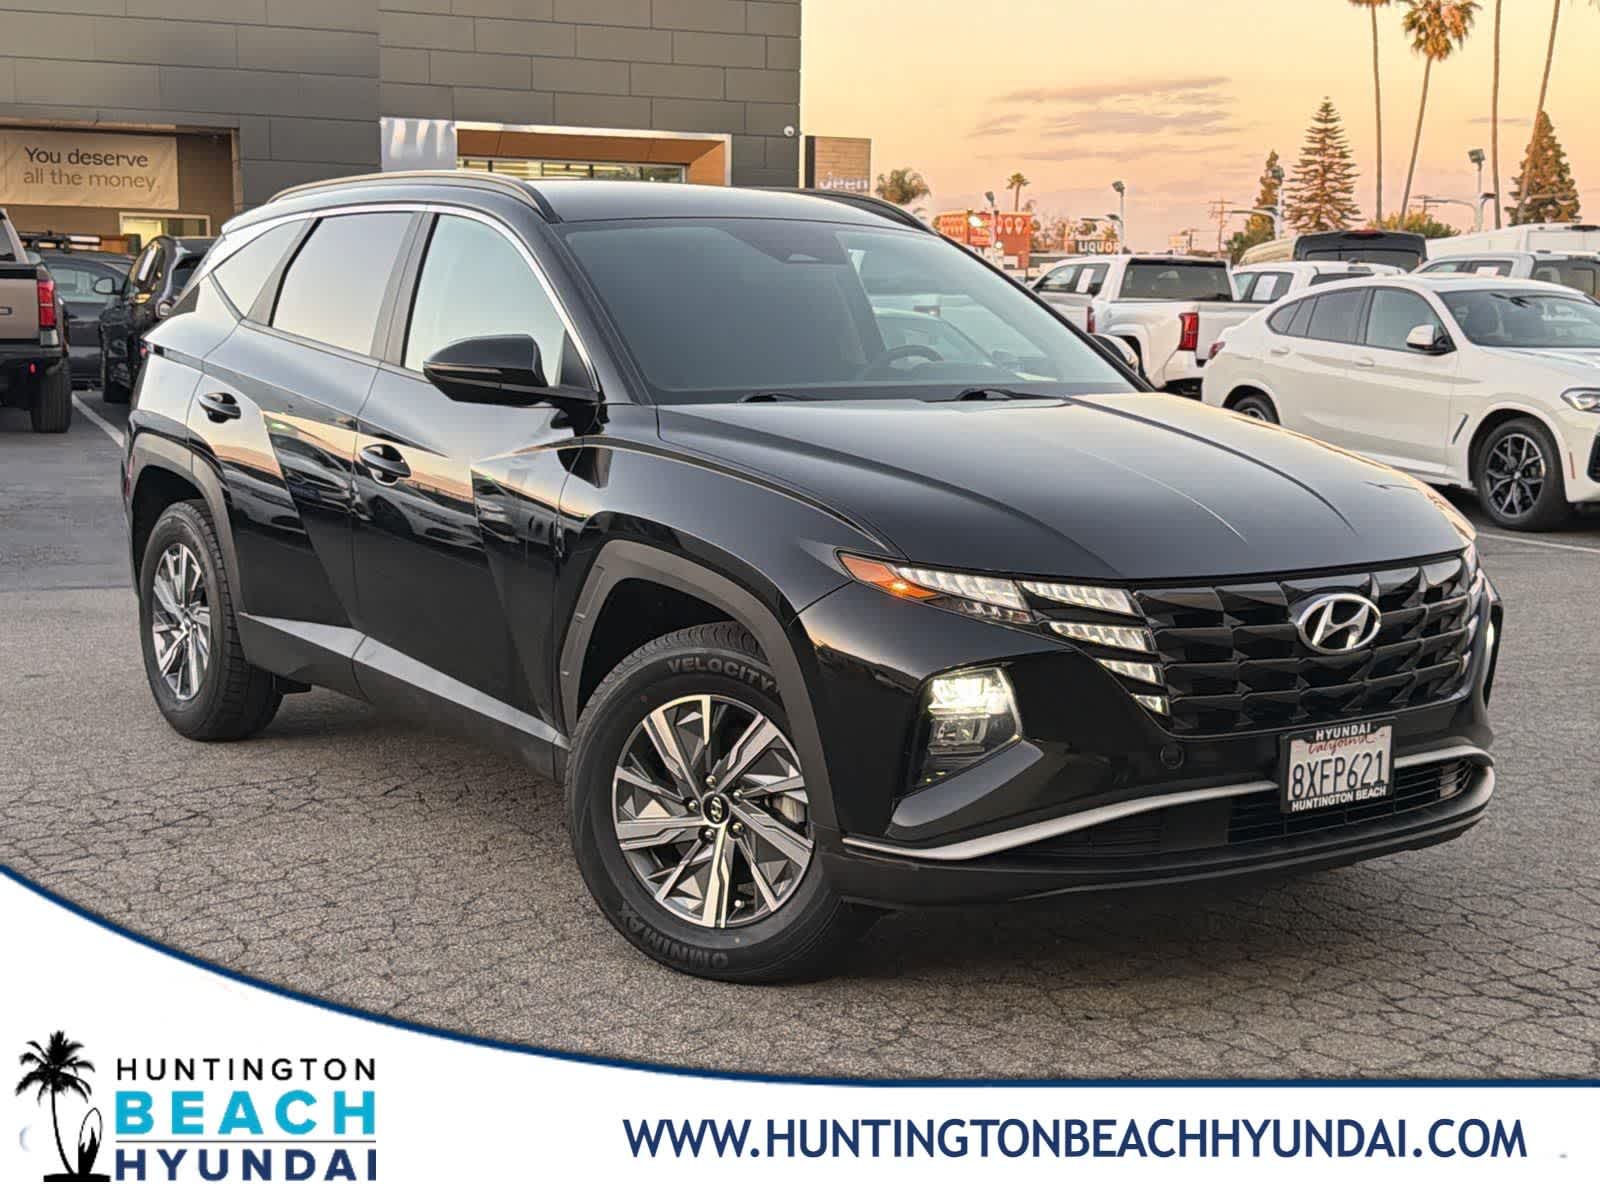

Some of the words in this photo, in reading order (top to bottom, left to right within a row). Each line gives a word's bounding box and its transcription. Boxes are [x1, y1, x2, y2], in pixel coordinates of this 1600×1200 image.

[24, 147, 61, 164] You
[68, 148, 149, 168] deserve
[24, 168, 44, 185] all
[51, 169, 82, 186] the
[89, 175, 160, 192] money.
[667, 657, 775, 691] VELOCITY
[1315, 722, 1371, 741] HYUNDAI
[1291, 750, 1385, 800] 8XFP621
[1291, 791, 1354, 812] HUNTINGTON
[1355, 786, 1387, 803] BEACH
